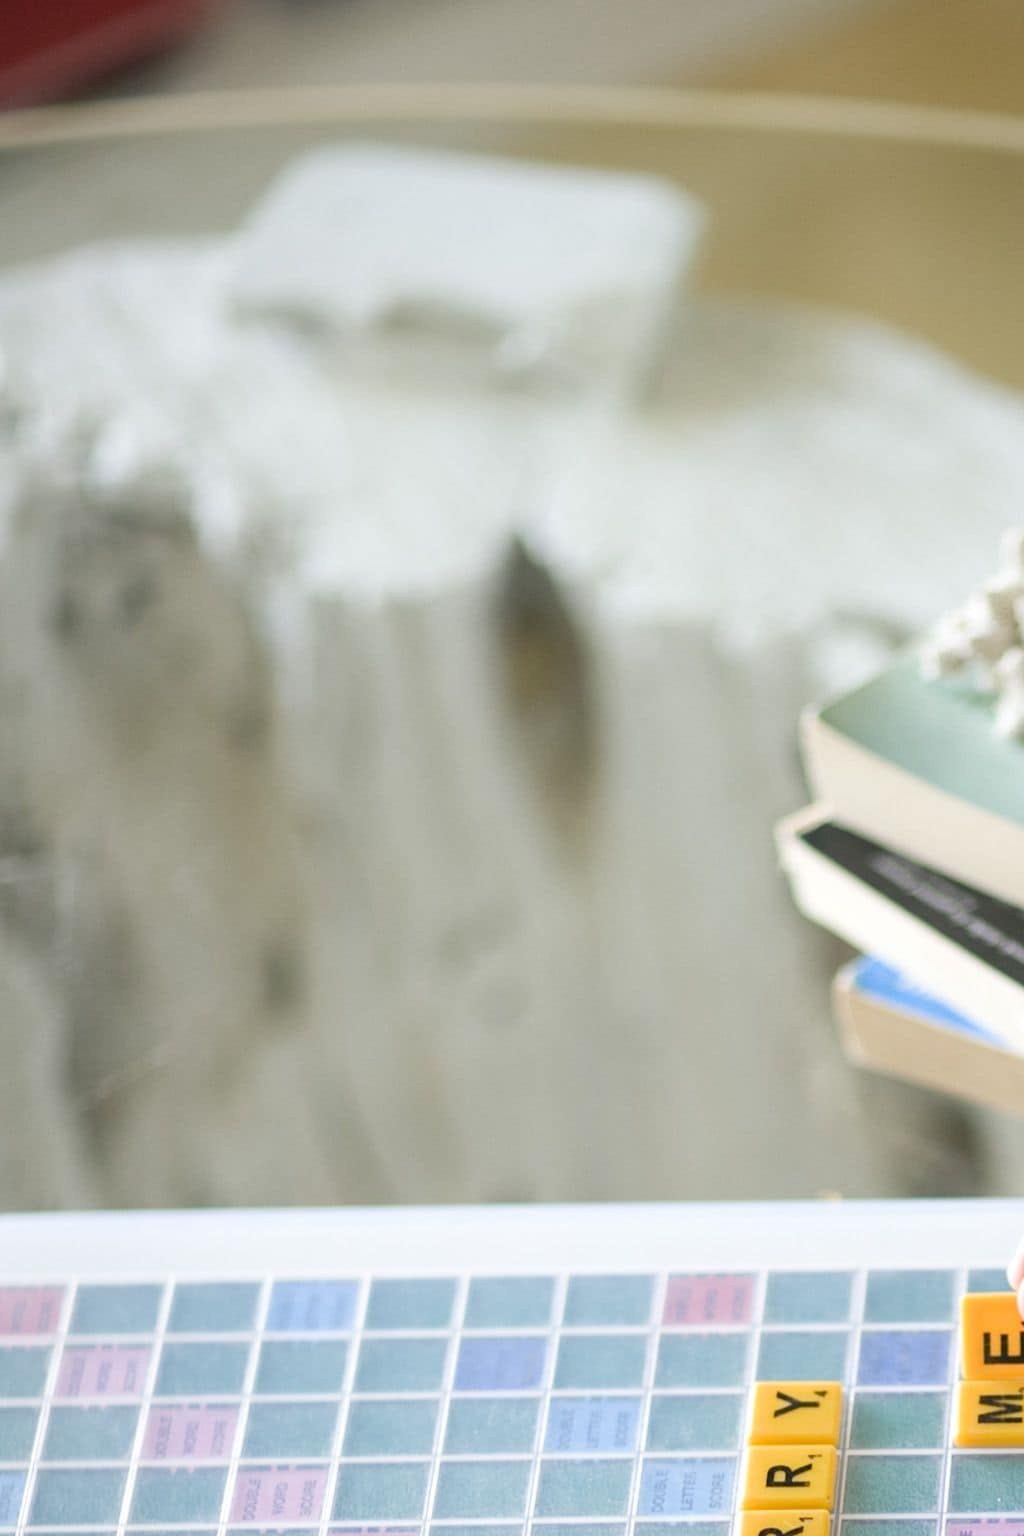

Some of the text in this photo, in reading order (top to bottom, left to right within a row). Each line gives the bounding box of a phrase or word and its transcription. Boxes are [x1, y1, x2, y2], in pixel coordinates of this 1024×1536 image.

[651, 1470, 670, 1513] DOUBLE
[680, 1472, 697, 1511] LETTER
[709, 1472, 726, 1509] SCORE
